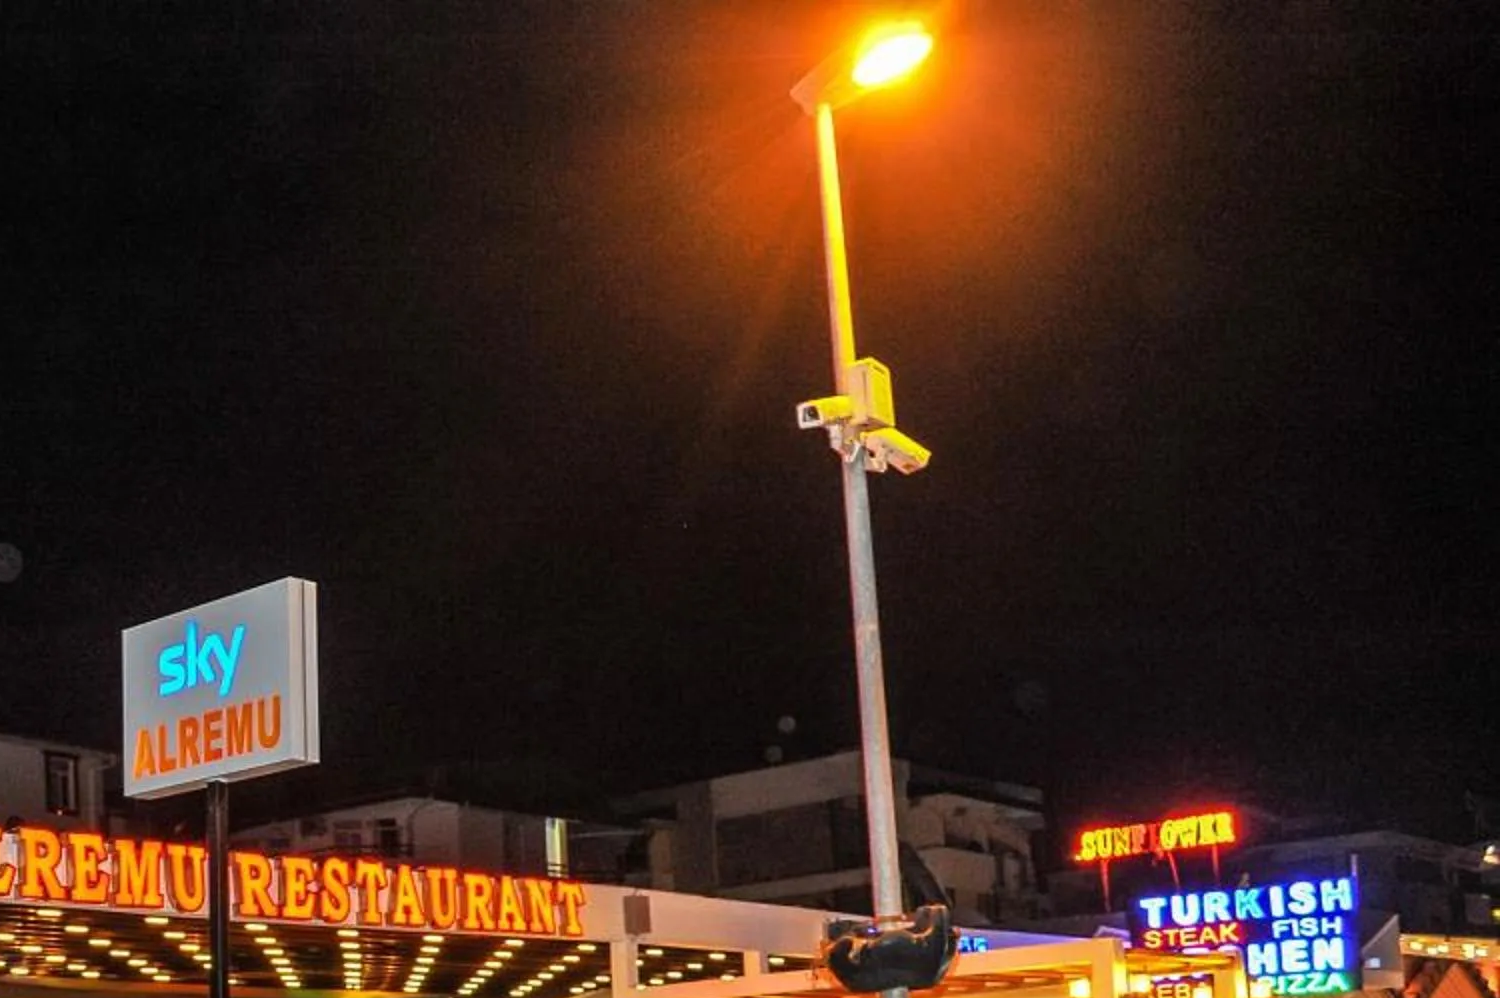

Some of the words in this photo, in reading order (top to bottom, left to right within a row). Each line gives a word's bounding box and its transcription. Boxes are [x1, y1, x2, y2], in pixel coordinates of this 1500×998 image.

[159, 619, 246, 697] sky
[133, 694, 282, 781] ALREMU
[233, 852, 586, 937] RESTAURANT
[1140, 878, 1353, 929] TURKISH
[1143, 922, 1241, 949] STEAK
[1272, 916, 1343, 939] FISH
